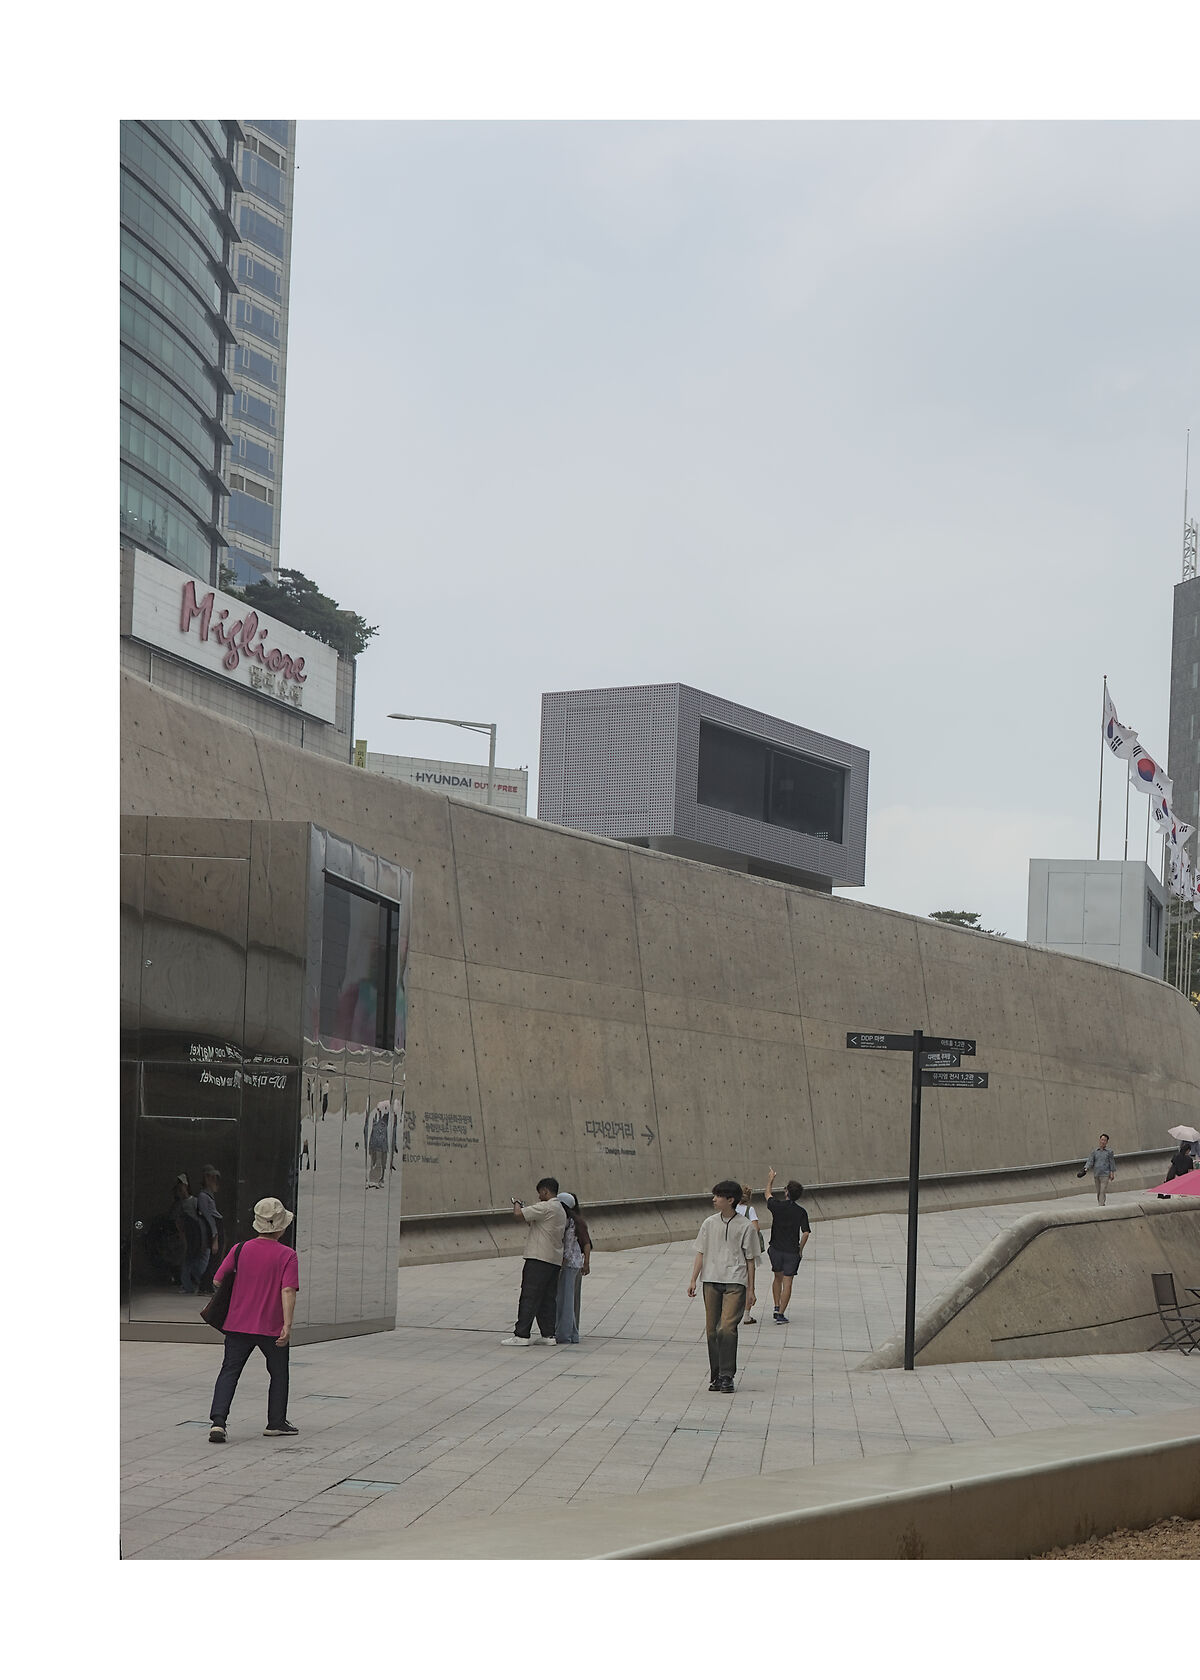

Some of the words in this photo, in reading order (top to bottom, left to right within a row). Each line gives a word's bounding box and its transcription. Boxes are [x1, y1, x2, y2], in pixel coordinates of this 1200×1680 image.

[180, 580, 307, 683] Migliore
[415, 771, 472, 788] HYUNDAI
[497, 784, 518, 793] FREE
[585, 1119, 635, 1140] 디자인거리
